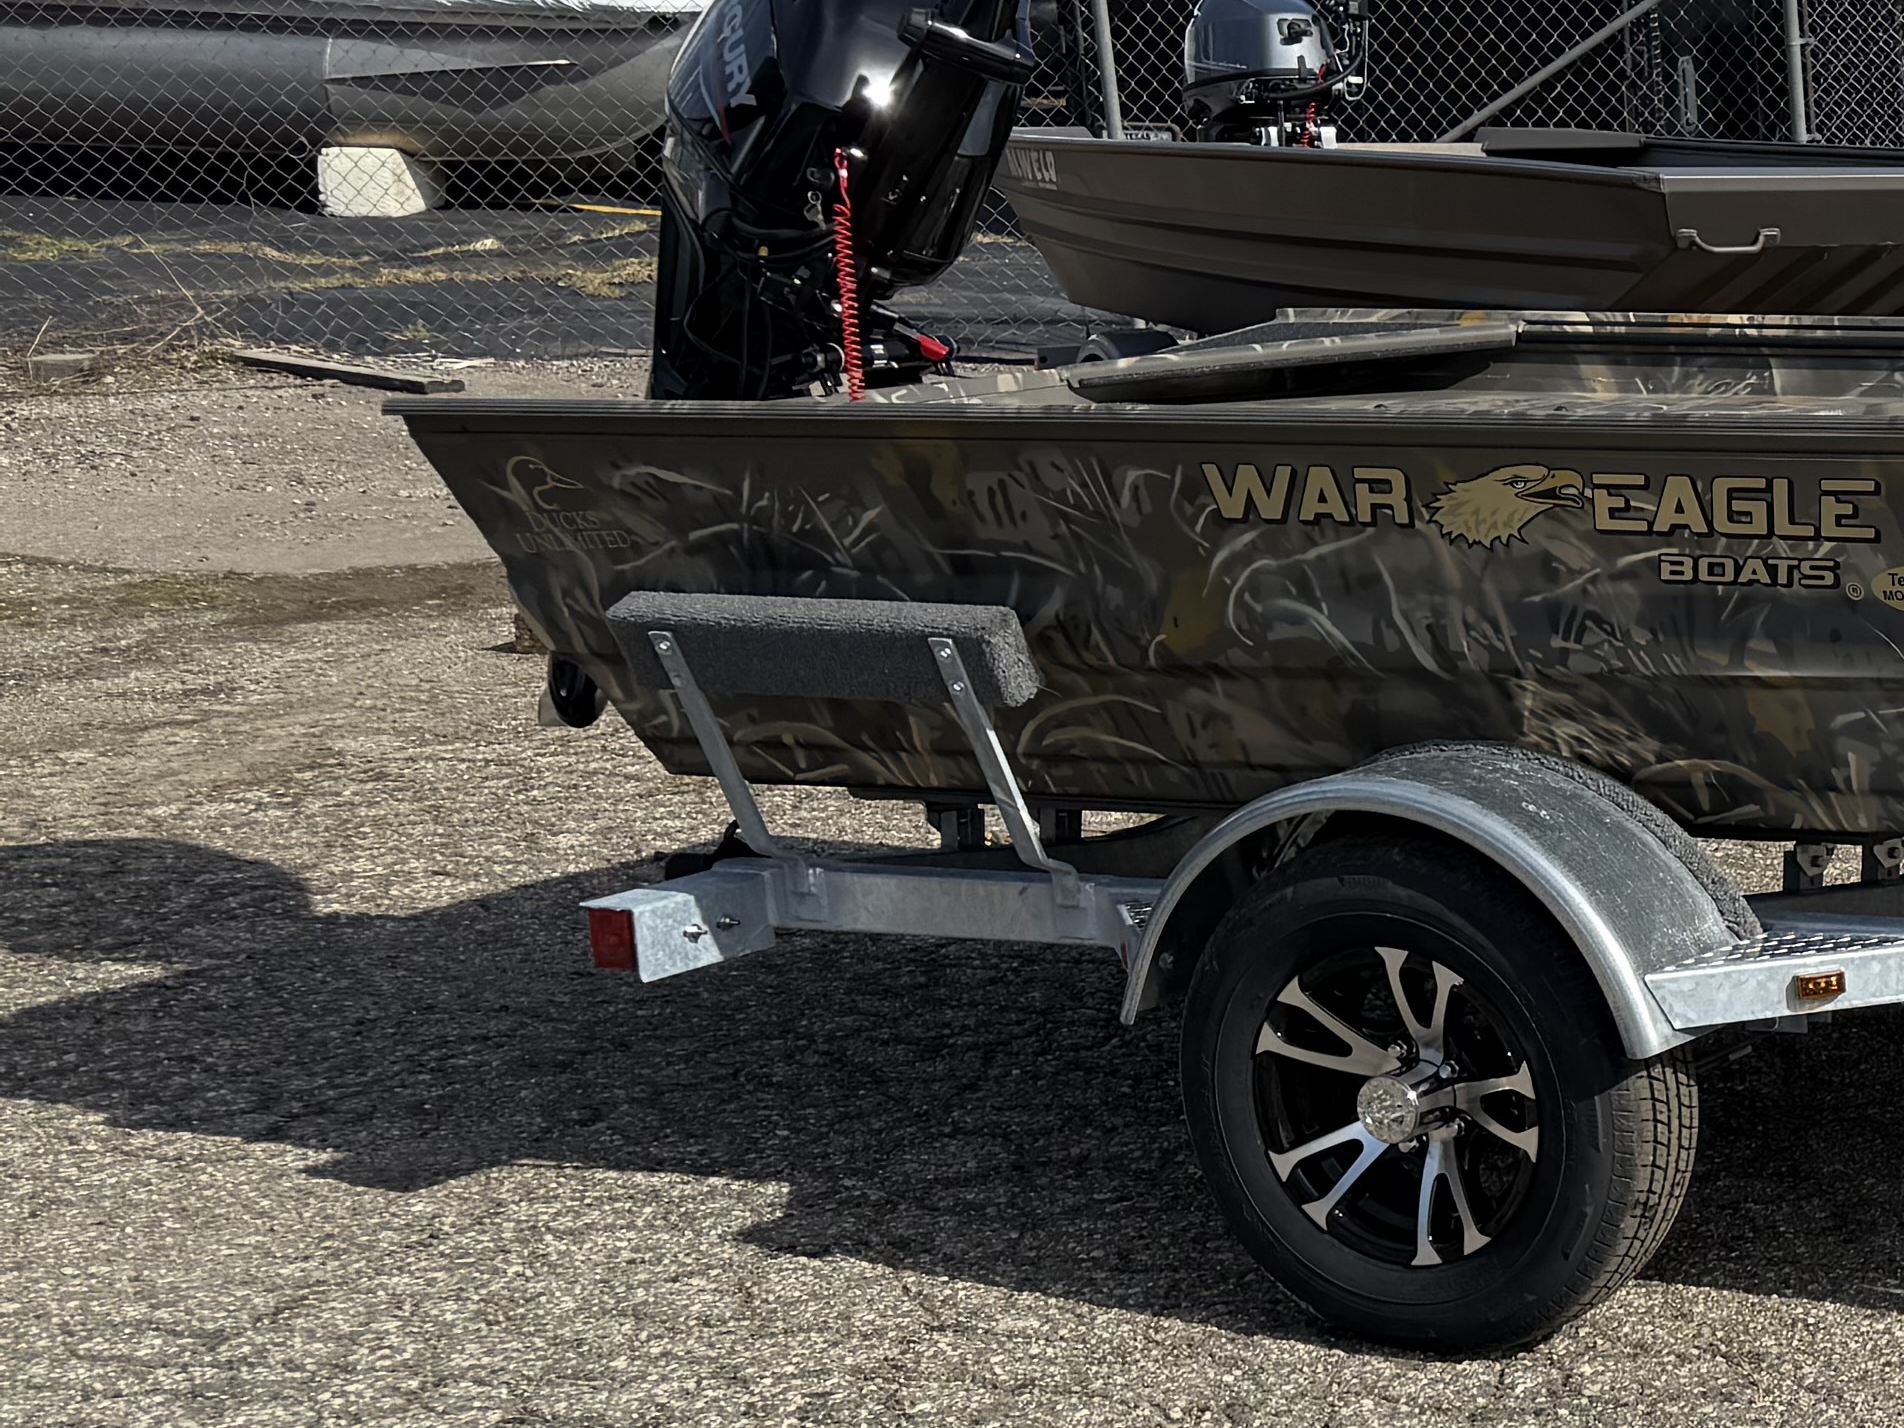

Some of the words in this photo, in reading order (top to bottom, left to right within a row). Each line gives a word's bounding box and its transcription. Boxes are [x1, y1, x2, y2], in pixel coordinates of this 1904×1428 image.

[1200, 462, 1414, 527] WAR
[1590, 473, 1879, 541] EAGLE
[527, 511, 599, 532] DUCKS
[515, 530, 631, 553] UNLIMITED
[1659, 554, 1840, 587] BOATS
